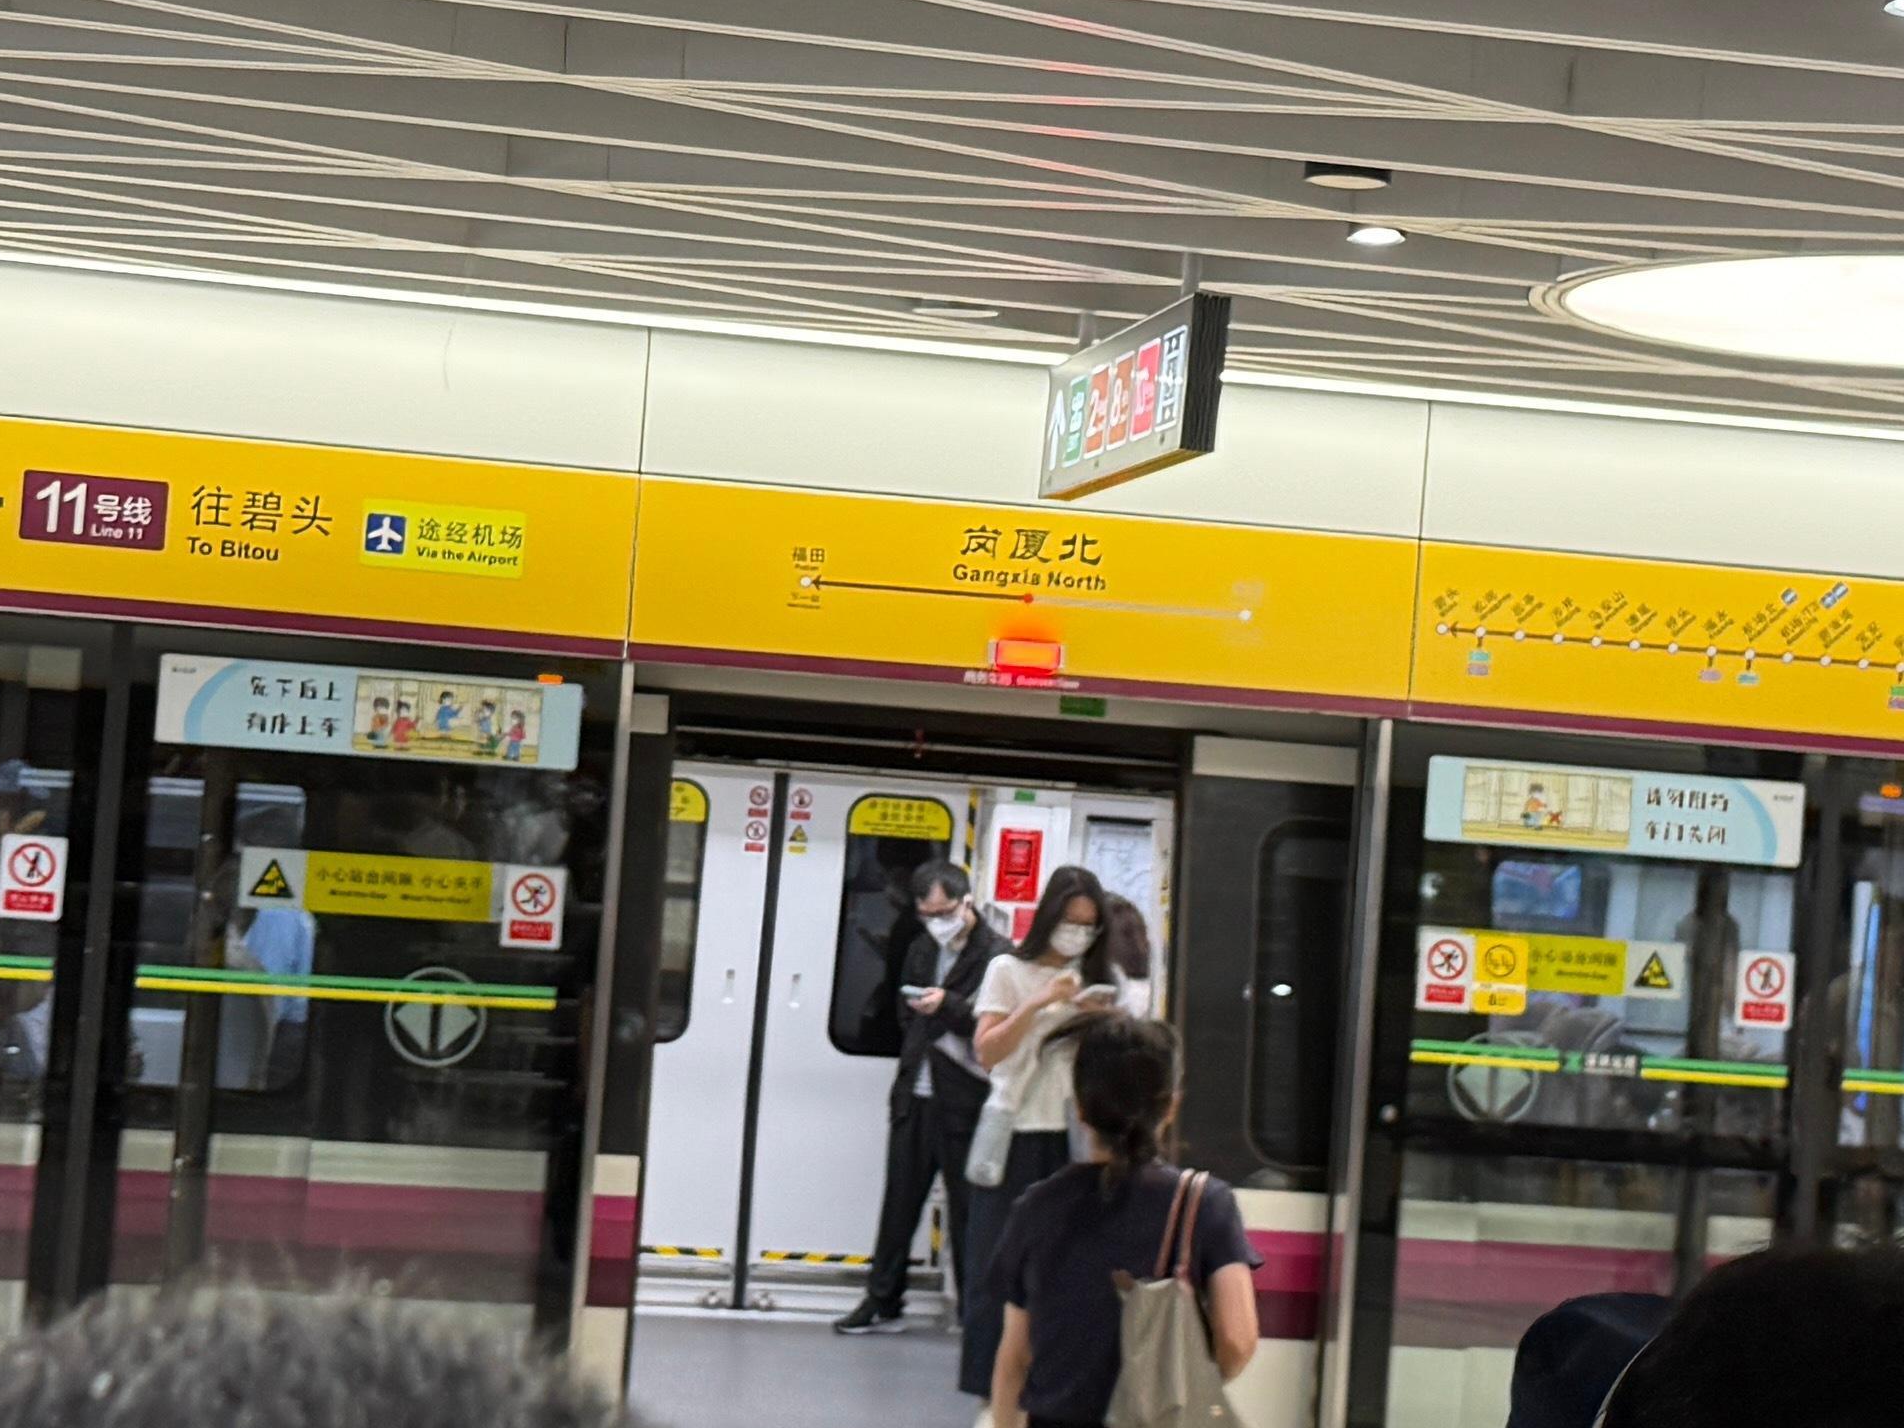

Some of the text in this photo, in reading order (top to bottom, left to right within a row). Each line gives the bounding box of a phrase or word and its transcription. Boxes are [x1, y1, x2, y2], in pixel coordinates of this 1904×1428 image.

[190, 484, 333, 538] 往碧头
[91, 523, 143, 541] Line 11
[416, 517, 523, 551] 途经机场
[960, 525, 1103, 566] 岗厦北
[187, 536, 280, 562] To Bitou
[416, 547, 519, 568] Via the Airport
[952, 563, 1106, 591] Gangxia North
